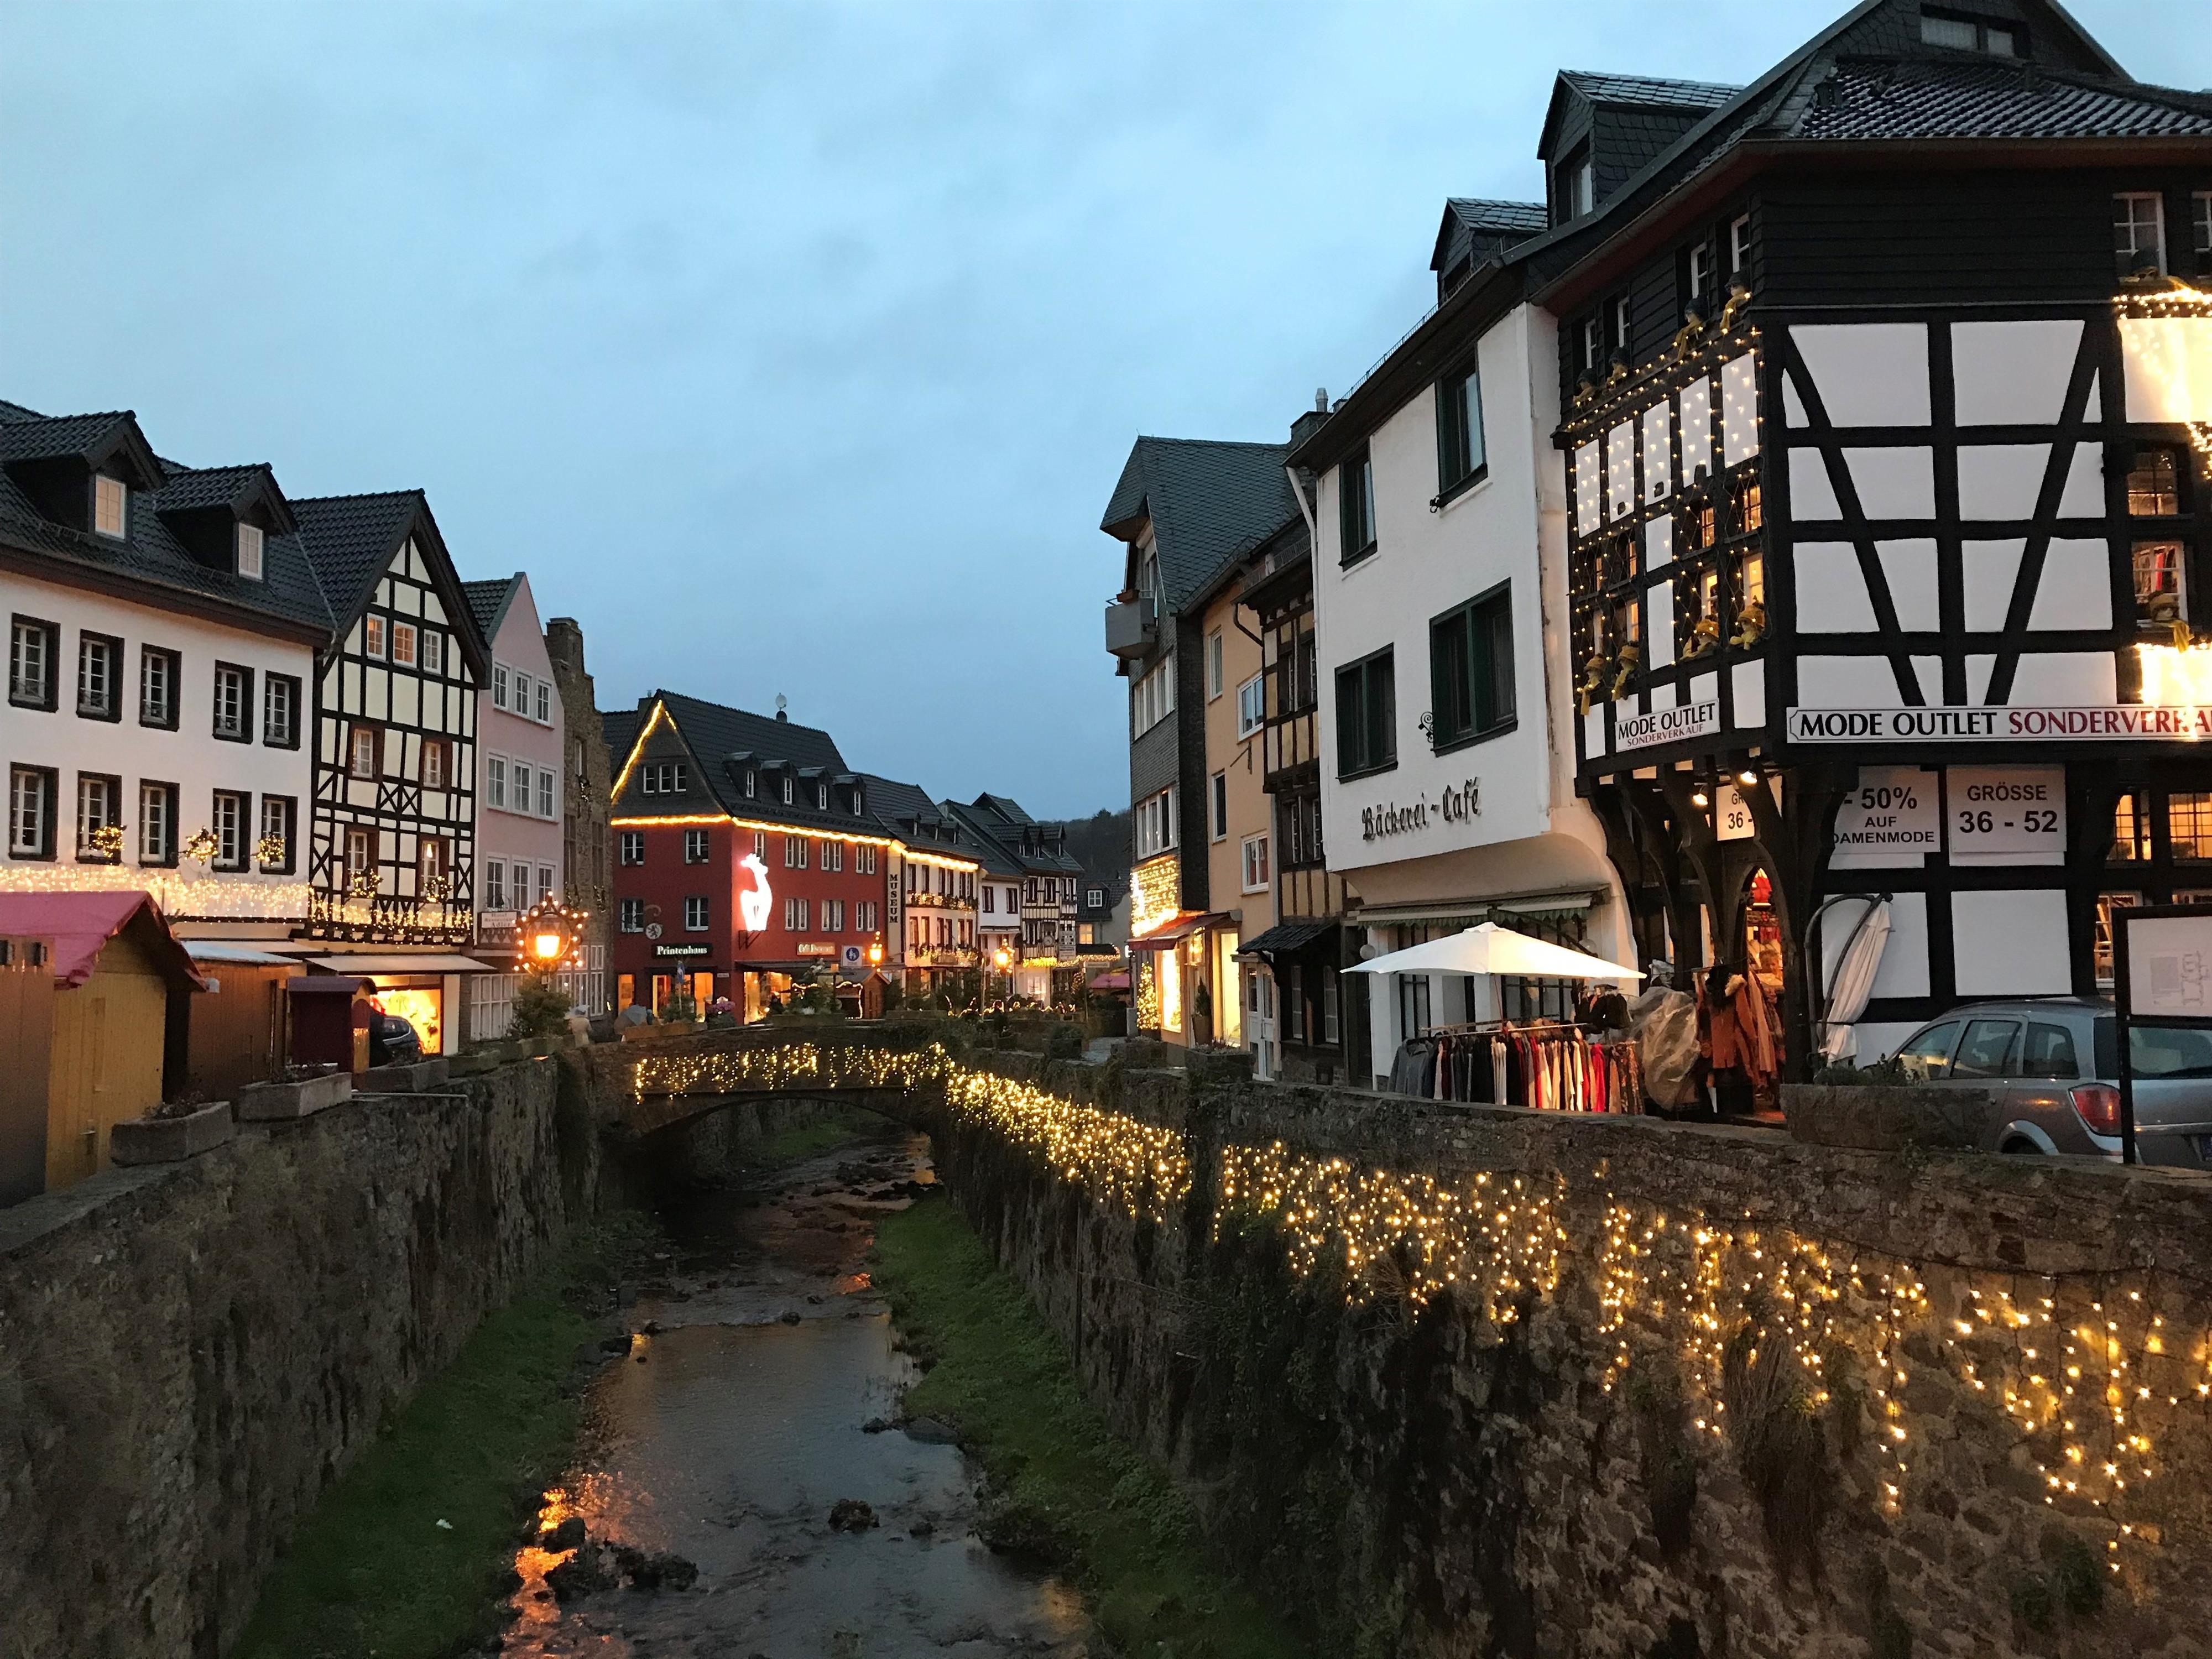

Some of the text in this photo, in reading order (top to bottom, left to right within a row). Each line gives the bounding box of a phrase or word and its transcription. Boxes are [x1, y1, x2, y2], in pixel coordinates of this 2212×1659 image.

[1619, 703, 1715, 740] MODE OUTLET
[1800, 711, 2212, 737] MODE OUTLET SONDERVERKA
[1627, 724, 1704, 747] SONDERVERKAUF
[1861, 786, 1917, 809] 50%
[1967, 781, 2047, 801] GRÖSSE
[1728, 812, 1744, 830] 36
[1864, 816, 1897, 828] AUF
[1959, 811, 1993, 833] 36
[2024, 810, 2058, 833] 52
[889, 874, 898, 923] MUSEUM
[656, 945, 708, 955] Printenhaus
